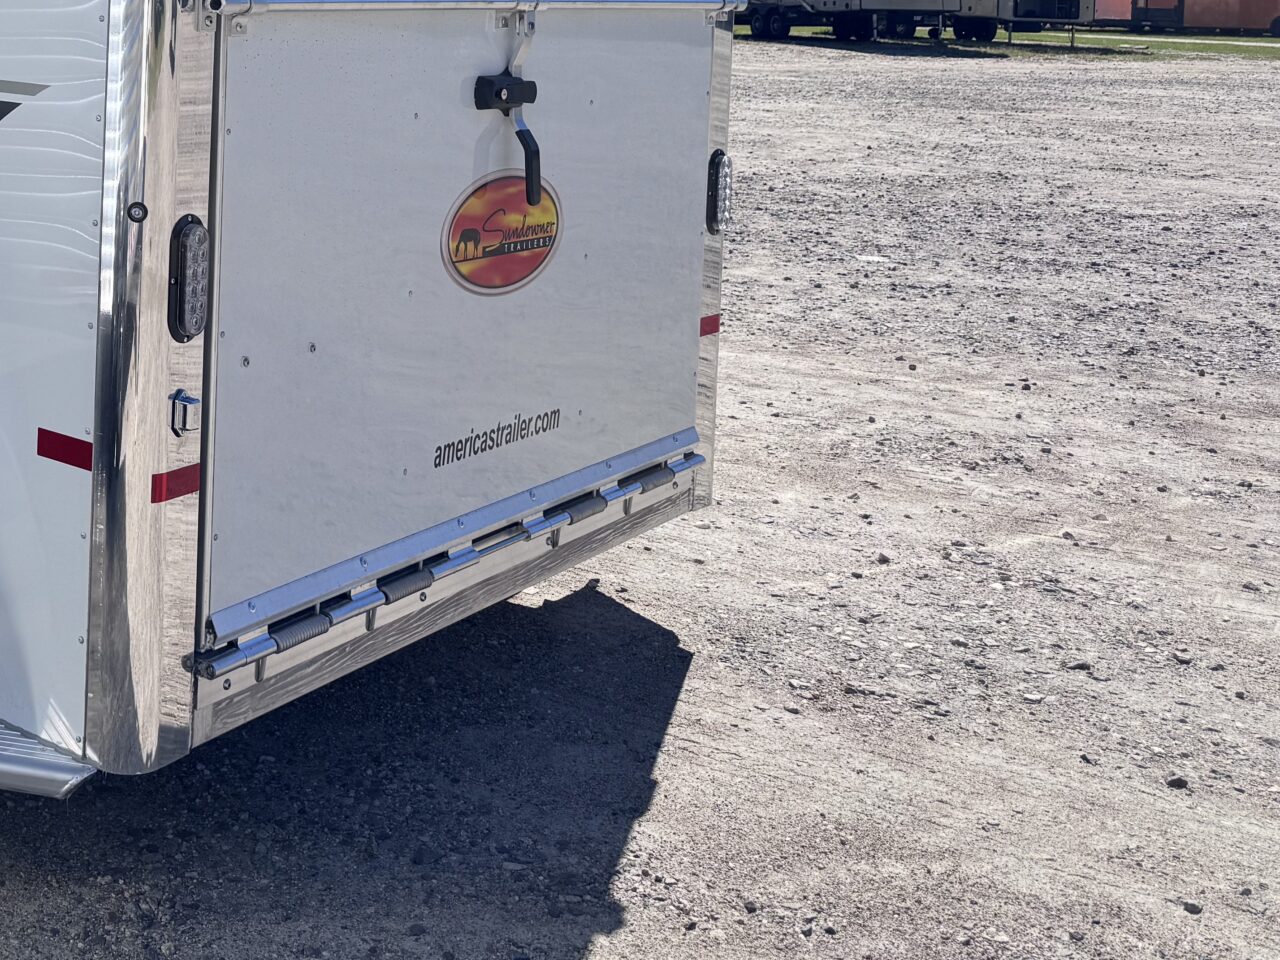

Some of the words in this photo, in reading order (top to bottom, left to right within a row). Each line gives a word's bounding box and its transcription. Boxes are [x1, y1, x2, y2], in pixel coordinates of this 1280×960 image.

[482, 208, 556, 251] Sundowner
[504, 237, 550, 253] TRAILERS
[433, 408, 561, 469] americastrailer.com
